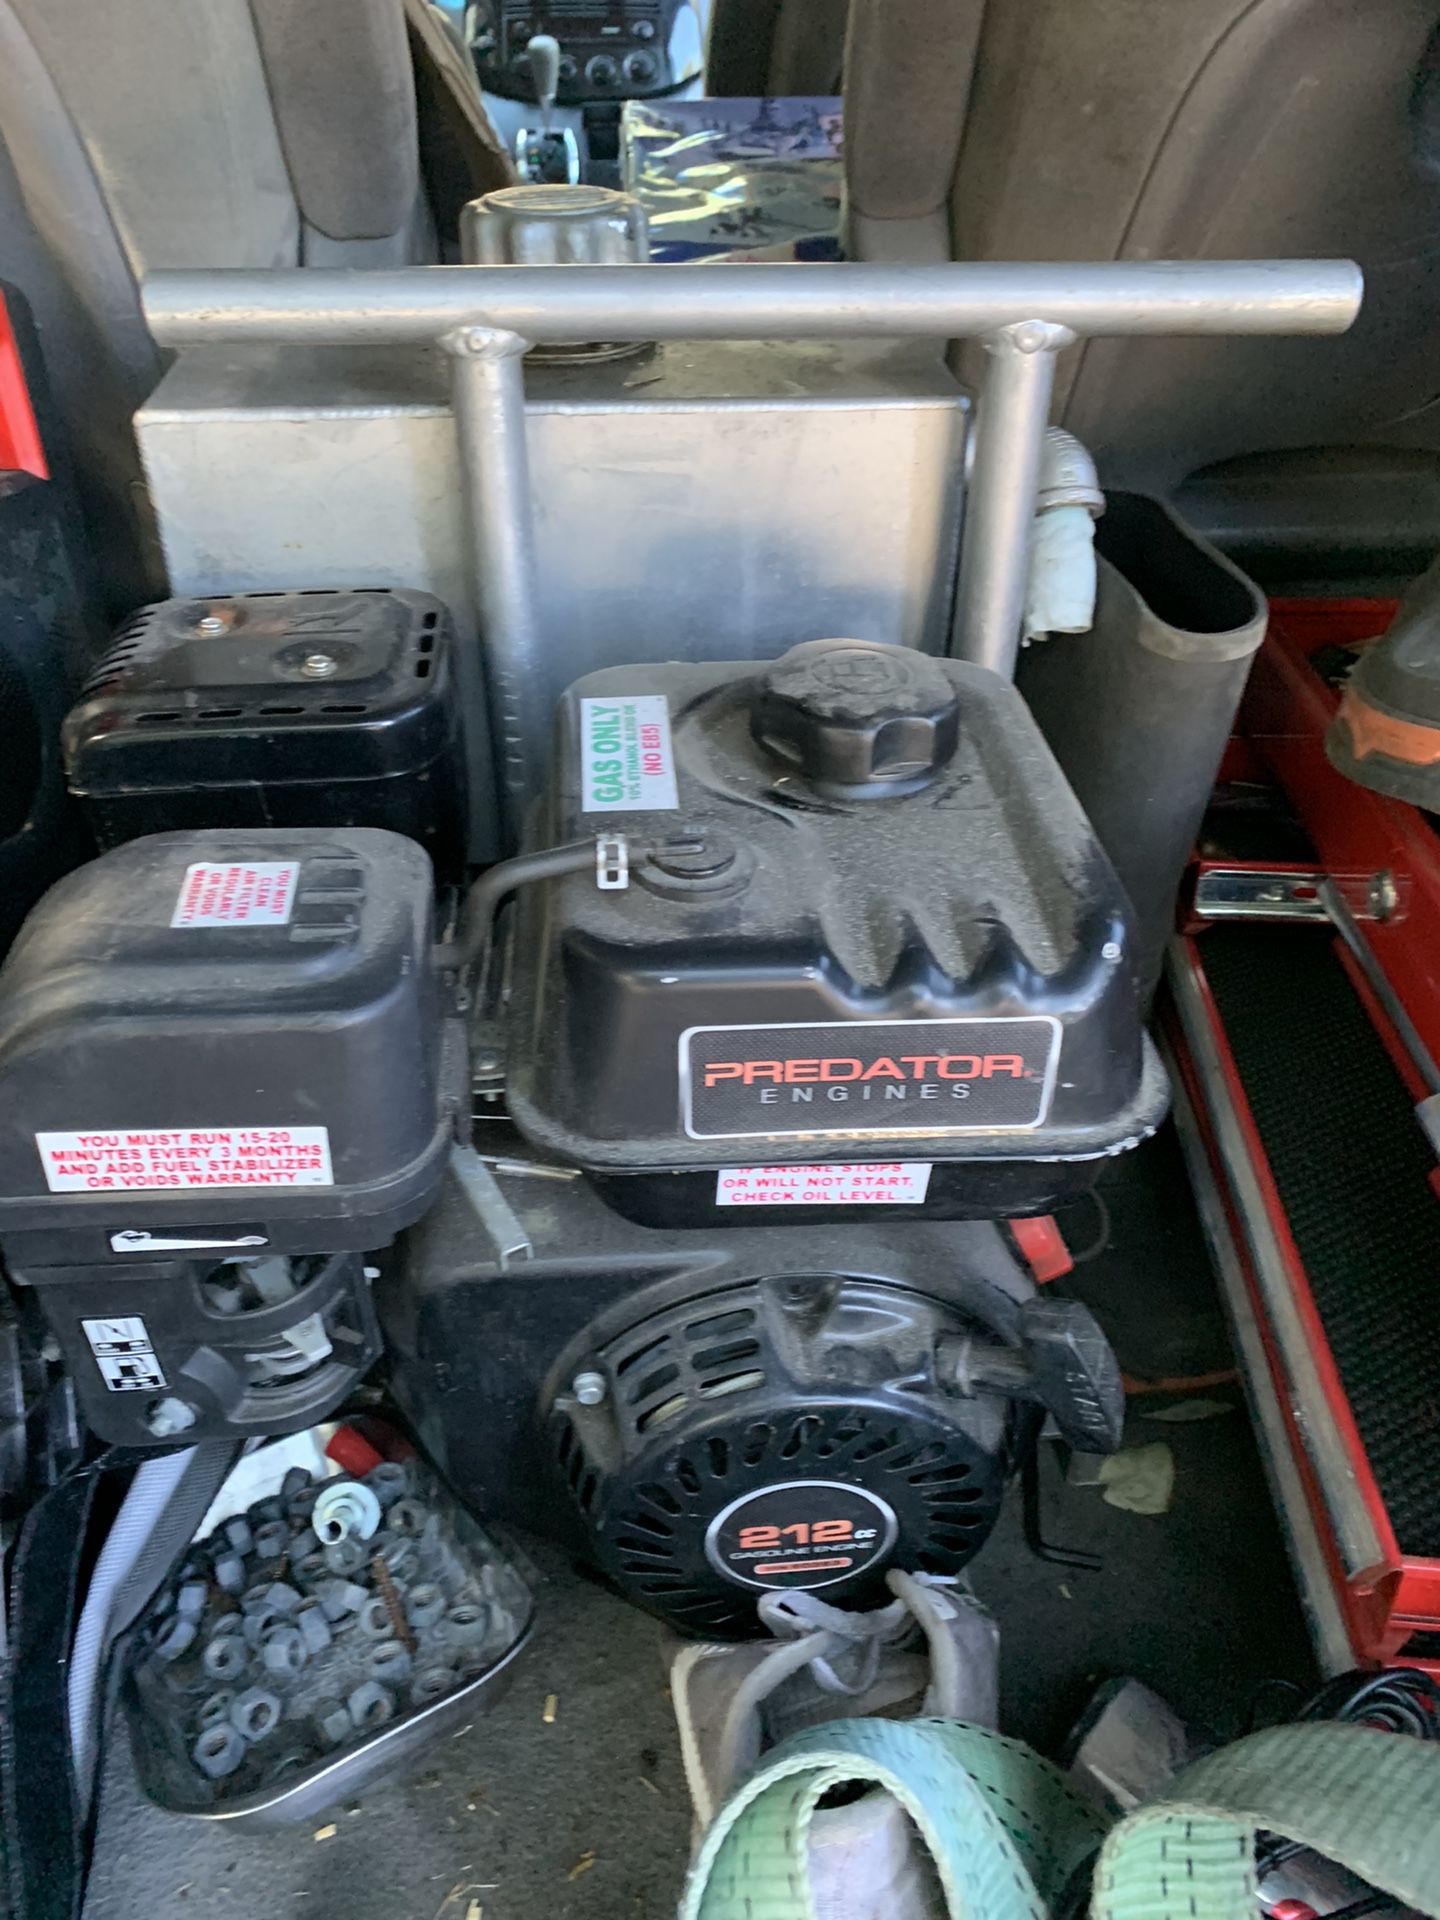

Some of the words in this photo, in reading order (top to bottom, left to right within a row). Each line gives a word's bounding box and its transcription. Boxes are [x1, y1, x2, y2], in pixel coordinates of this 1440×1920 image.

[591, 705, 621, 754] ONLY
[641, 724, 662, 749] E85)
[626, 743, 641, 781] ETHANOL
[642, 753, 666, 775] (NO
[592, 760, 623, 802] GAS
[209, 873, 222, 885] OR
[243, 870, 257, 885] AIR
[277, 870, 292, 887] YOU
[182, 869, 207, 920] WARRANTY
[200, 887, 219, 916] VOIDS
[216, 868, 241, 920] REGULARLY
[234, 887, 254, 919] FILTER
[255, 878, 273, 908] CLEAN
[270, 889, 288, 915] MUST
[704, 1054, 1026, 1087] PREDATOR
[760, 1083, 971, 1104] ENGINES
[77, 1135, 119, 1147] YOU
[127, 1134, 181, 1146] MUST
[190, 1133, 231, 1144] RUN
[240, 1131, 291, 1143] 15-20
[51, 1149, 142, 1161] MINUTES
[149, 1147, 211, 1159] EVERY
[220, 1146, 231, 1158] 3
[238, 1145, 322, 1157] MONTHS
[58, 1163, 98, 1175] AND
[106, 1162, 144, 1174] ADD
[151, 1161, 201, 1172] FUEL
[208, 1158, 322, 1171] STABILIZER
[87, 1176, 114, 1188] OR
[120, 1174, 180, 1186] VOIDS
[186, 1172, 296, 1184] WARRANTY
[723, 1178, 749, 1189] OR
[756, 1177, 799, 1188] WILL
[807, 1176, 844, 1187] NOT
[731, 1191, 796, 1202] CHECK
[802, 1191, 832, 1201] OIL
[729, 1546, 811, 1560] GASOLINE
[813, 1541, 874, 1553] ENGINE
